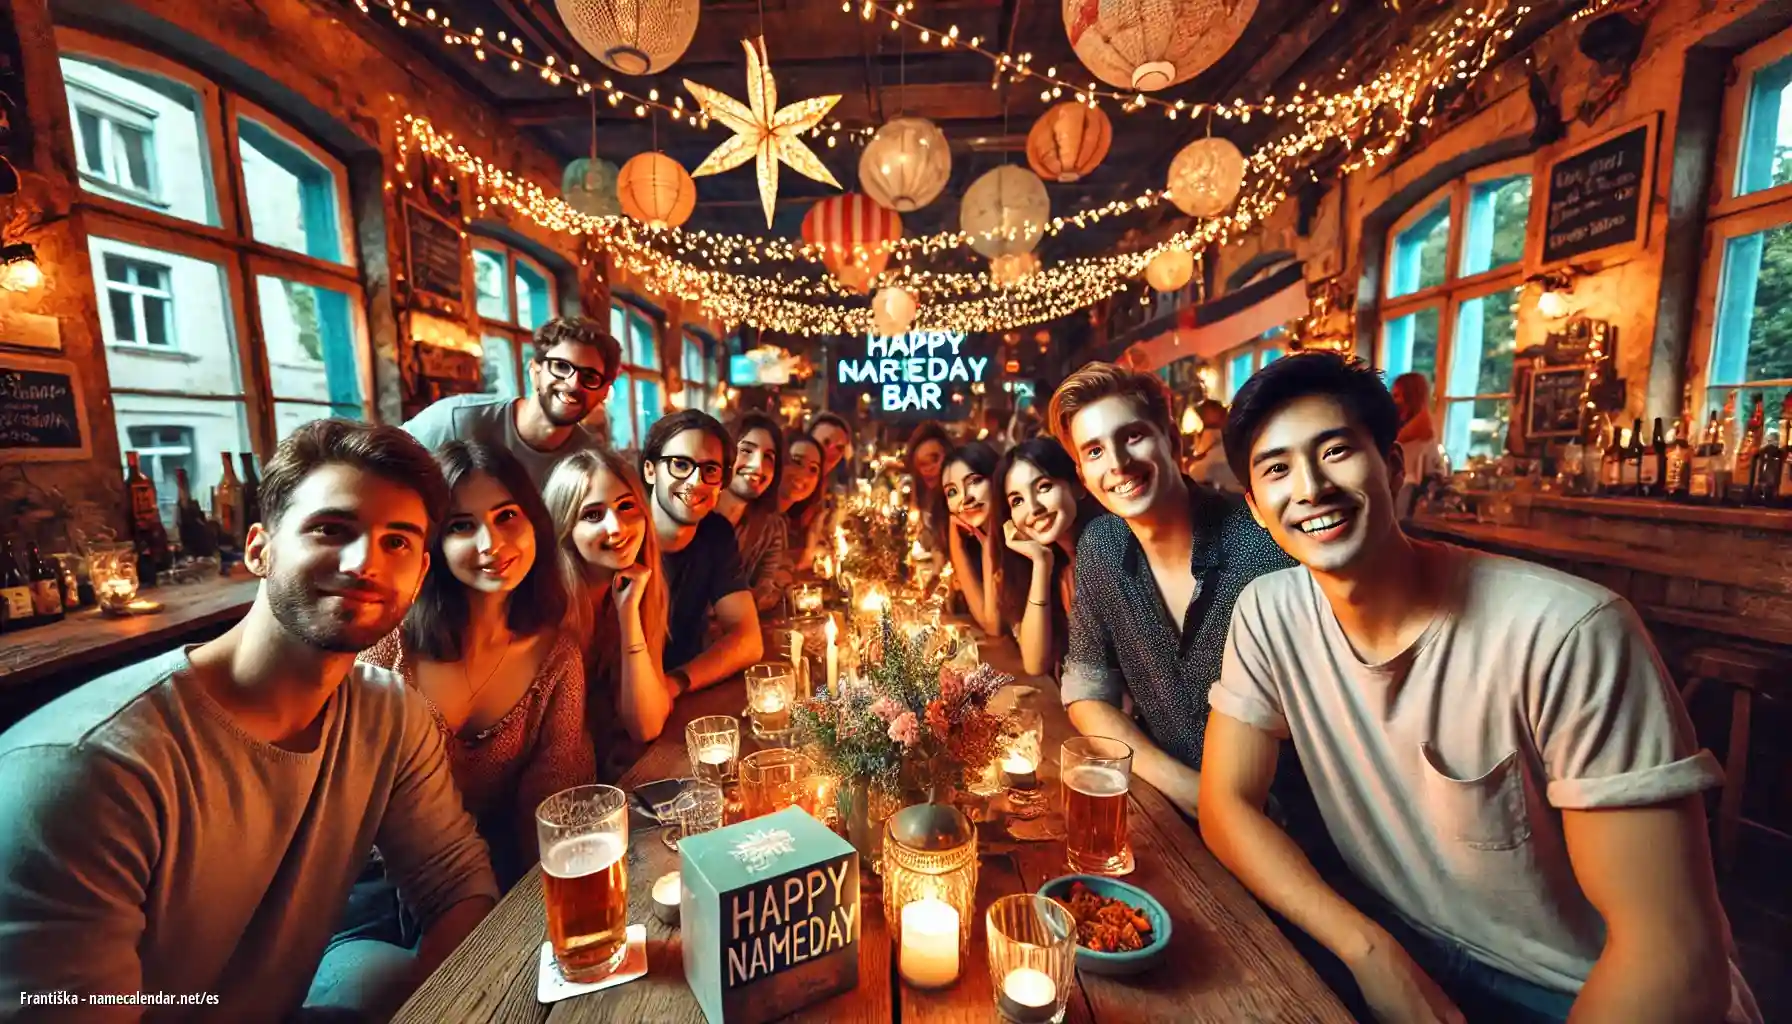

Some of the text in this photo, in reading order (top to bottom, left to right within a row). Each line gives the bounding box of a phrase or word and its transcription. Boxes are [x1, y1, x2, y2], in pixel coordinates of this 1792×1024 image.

[867, 331, 967, 357] HAPPY
[882, 382, 942, 412] BAR
[732, 860, 849, 940] HAPPY
[727, 903, 857, 987] NAMEDAY
